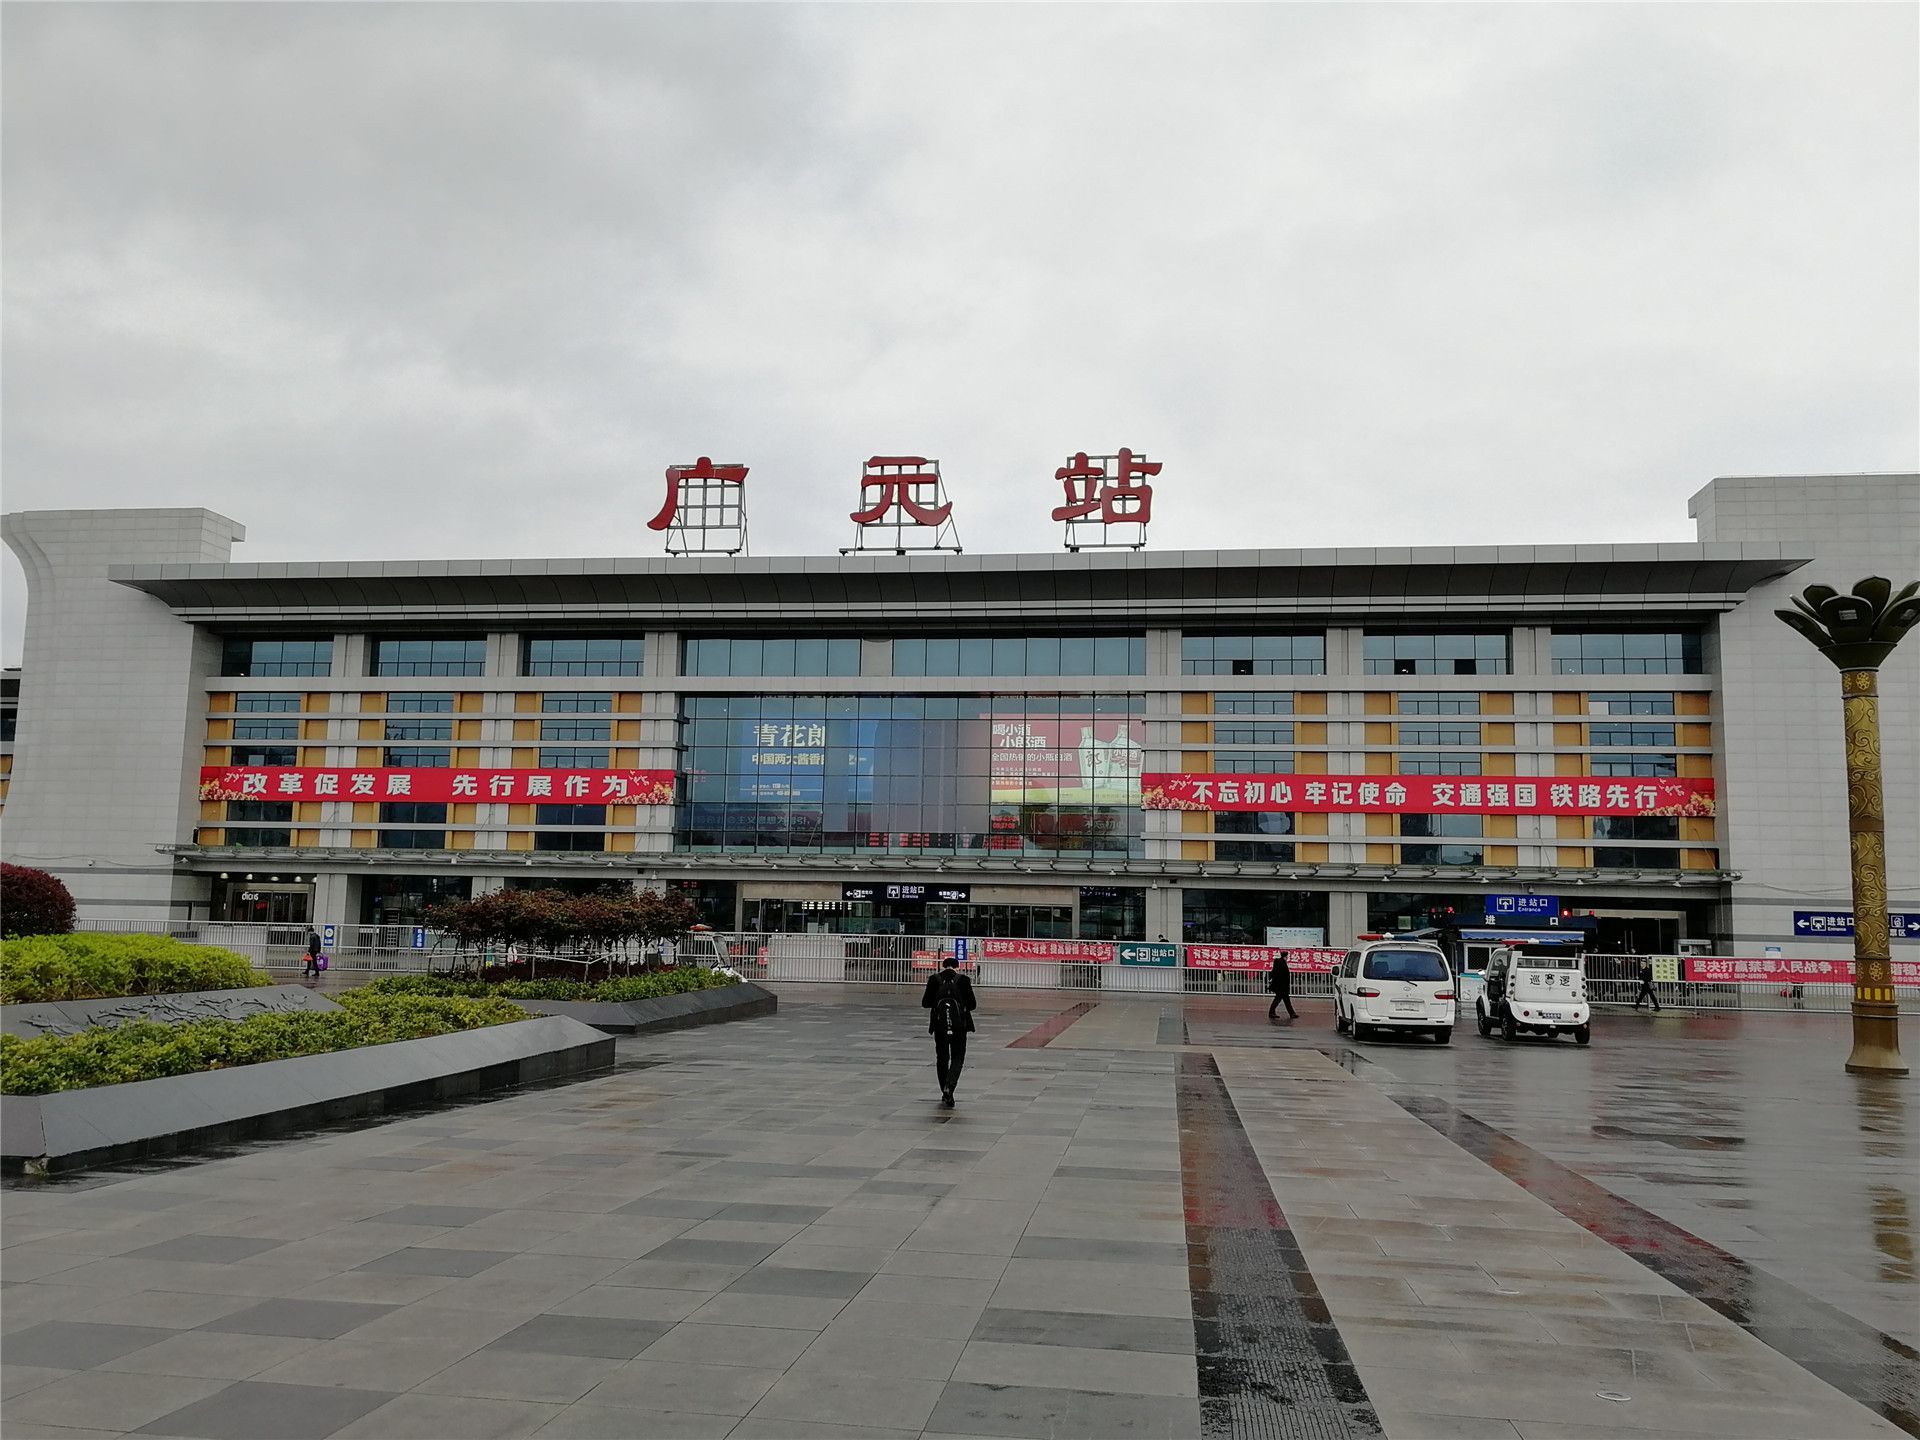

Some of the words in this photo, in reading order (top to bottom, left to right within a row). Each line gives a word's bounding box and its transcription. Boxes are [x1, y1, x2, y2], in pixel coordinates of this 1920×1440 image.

[647, 447, 1164, 531] 广元站
[242, 772, 413, 797] 改革促发展
[451, 773, 630, 798] 先行展作为
[1192, 780, 1294, 804] 不忘初心
[1304, 782, 1408, 806] 牢记使命
[1431, 782, 1538, 808] 交通强国
[1549, 783, 1659, 810] 铁路先行
[901, 885, 925, 894] 进站口
[1518, 898, 1548, 907] 进站口
[1827, 916, 1854, 927] 进站口
[1151, 949, 1175, 958] 出站口
[1529, 974, 1571, 987] 巡逻
